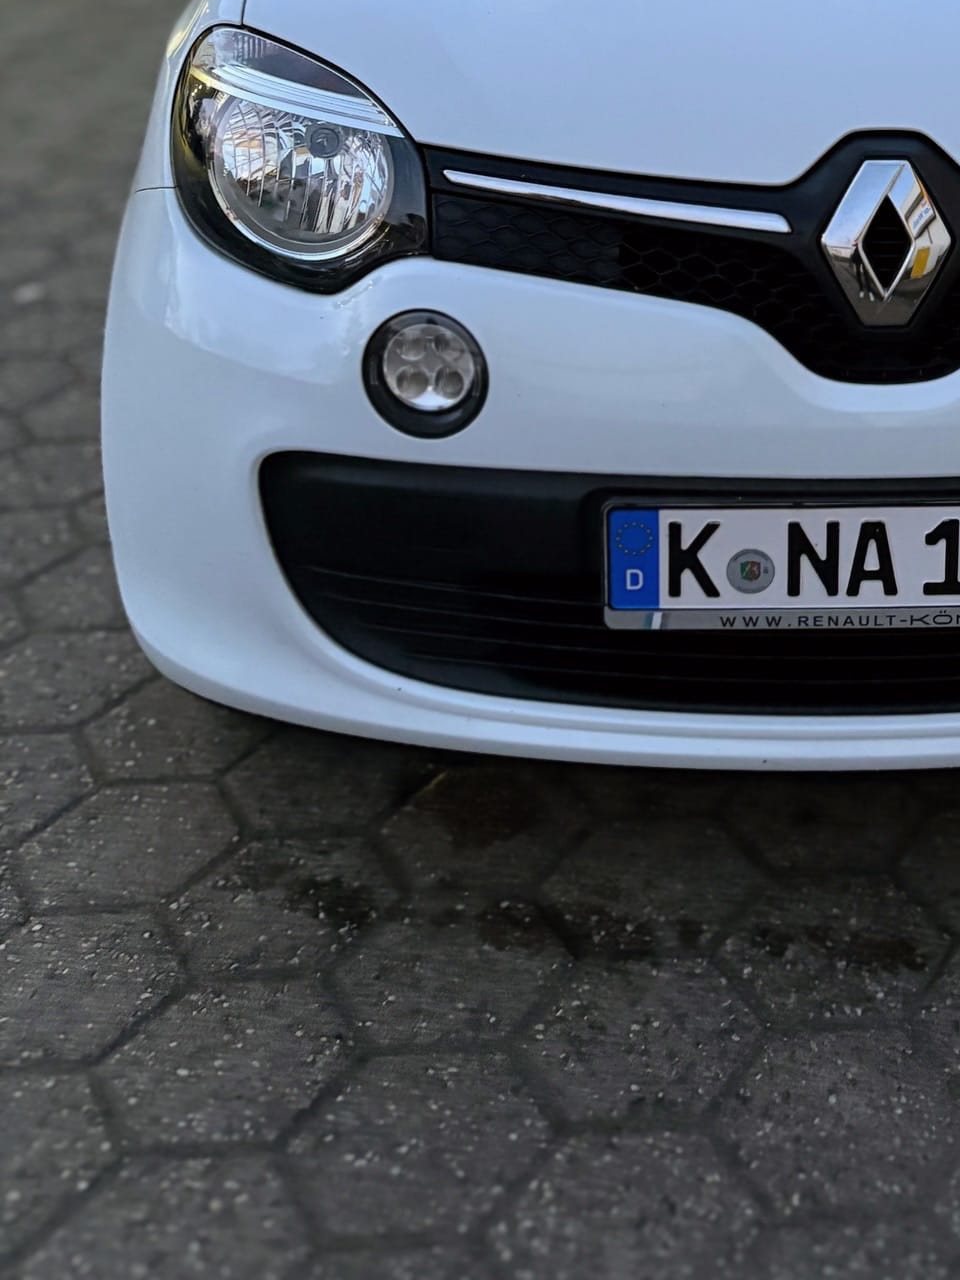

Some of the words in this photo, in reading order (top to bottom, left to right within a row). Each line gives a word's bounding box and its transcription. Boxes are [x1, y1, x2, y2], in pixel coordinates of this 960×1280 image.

[626, 569, 643, 591] D
[667, 520, 721, 598] K
[786, 520, 899, 598] NA
